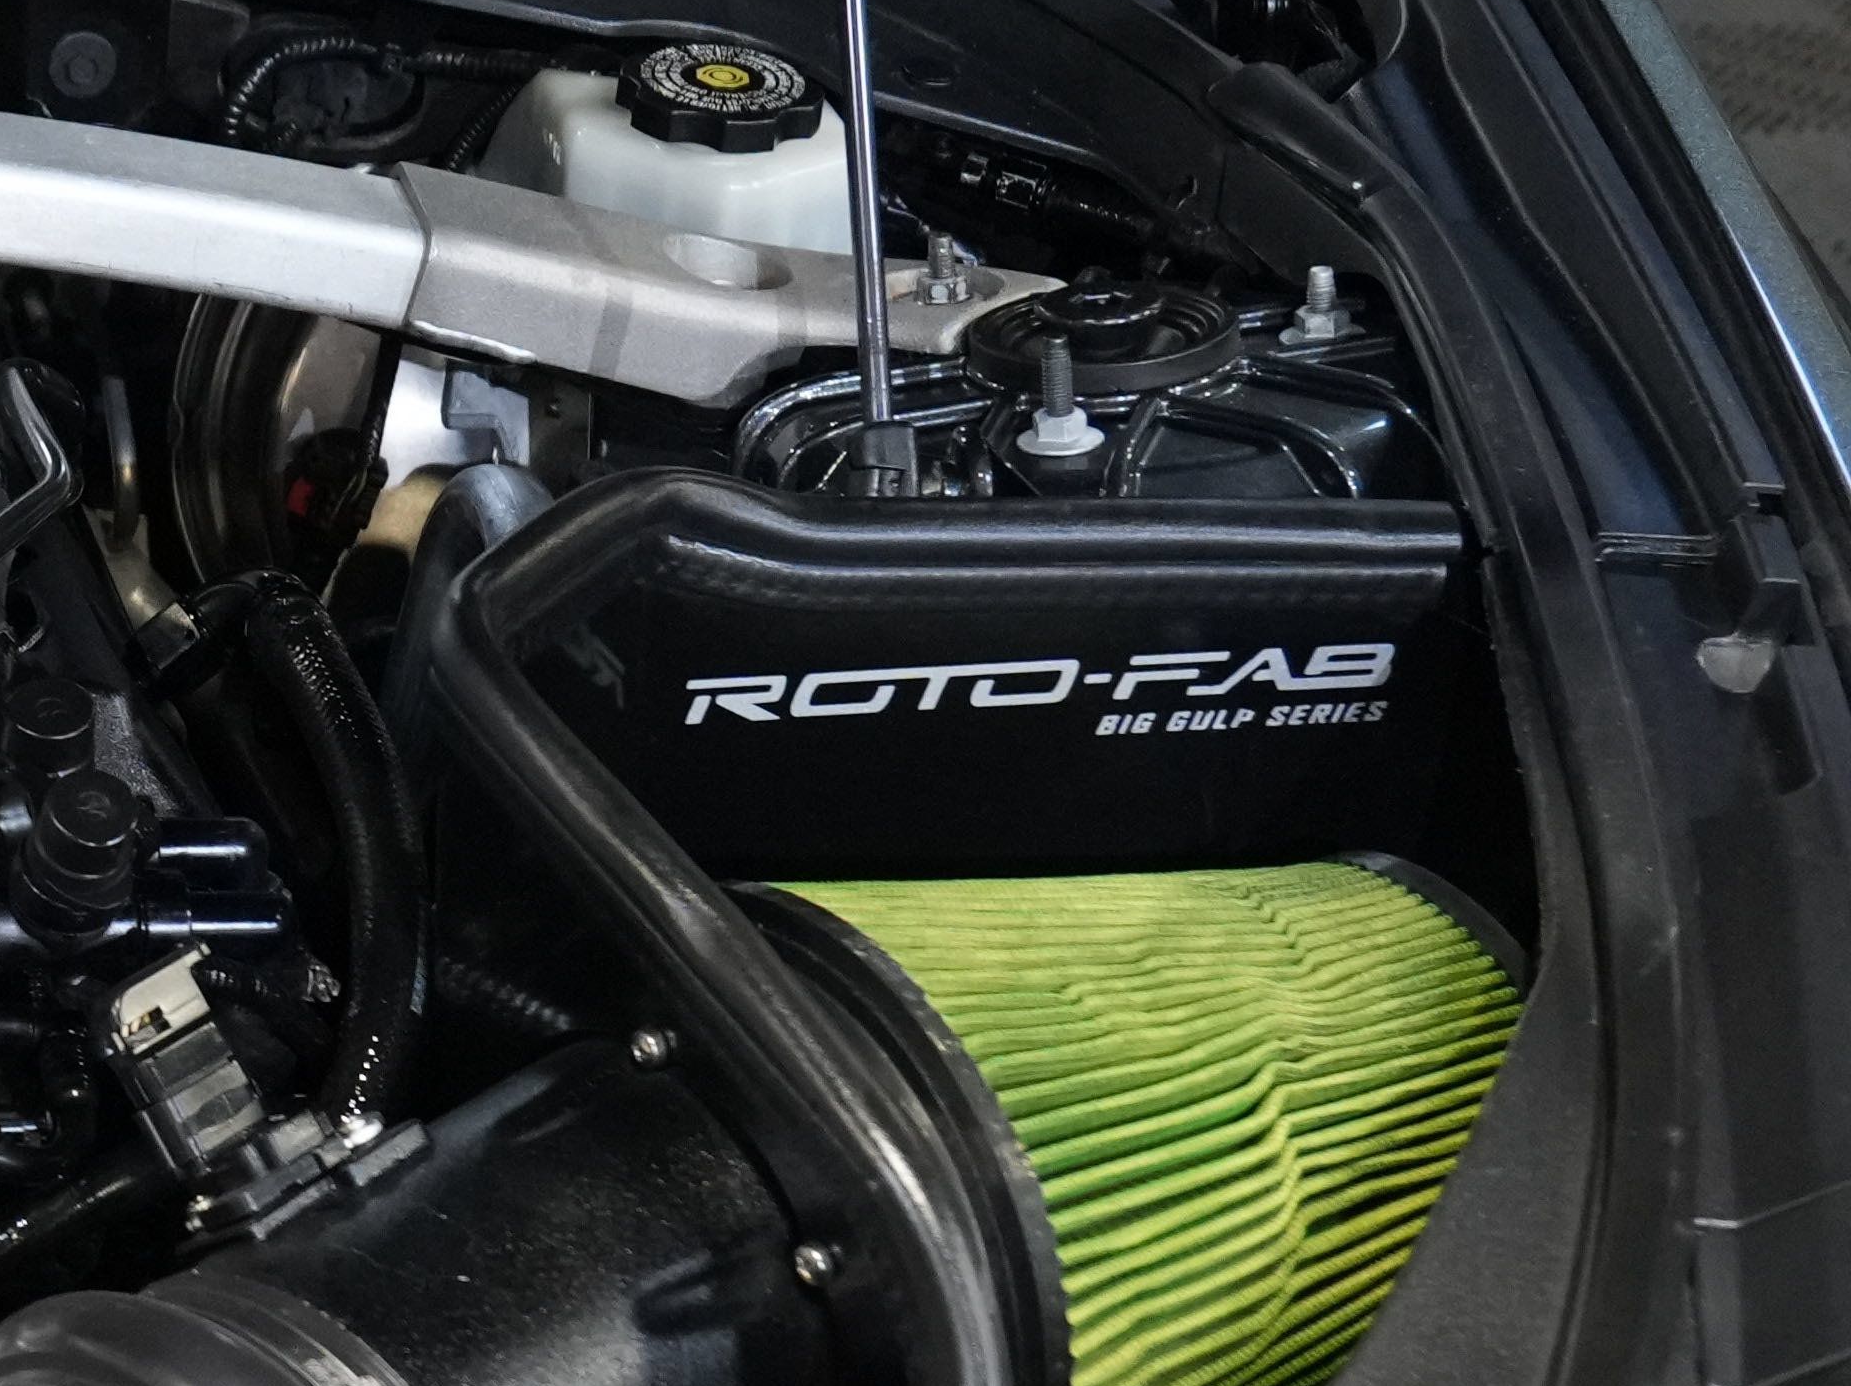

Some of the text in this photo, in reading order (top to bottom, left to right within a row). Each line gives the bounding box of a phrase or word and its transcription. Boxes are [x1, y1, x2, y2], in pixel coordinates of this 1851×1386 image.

[683, 643, 1396, 726] ROTO-FAB
[1095, 699, 1389, 736] BIG GULP SERIES
